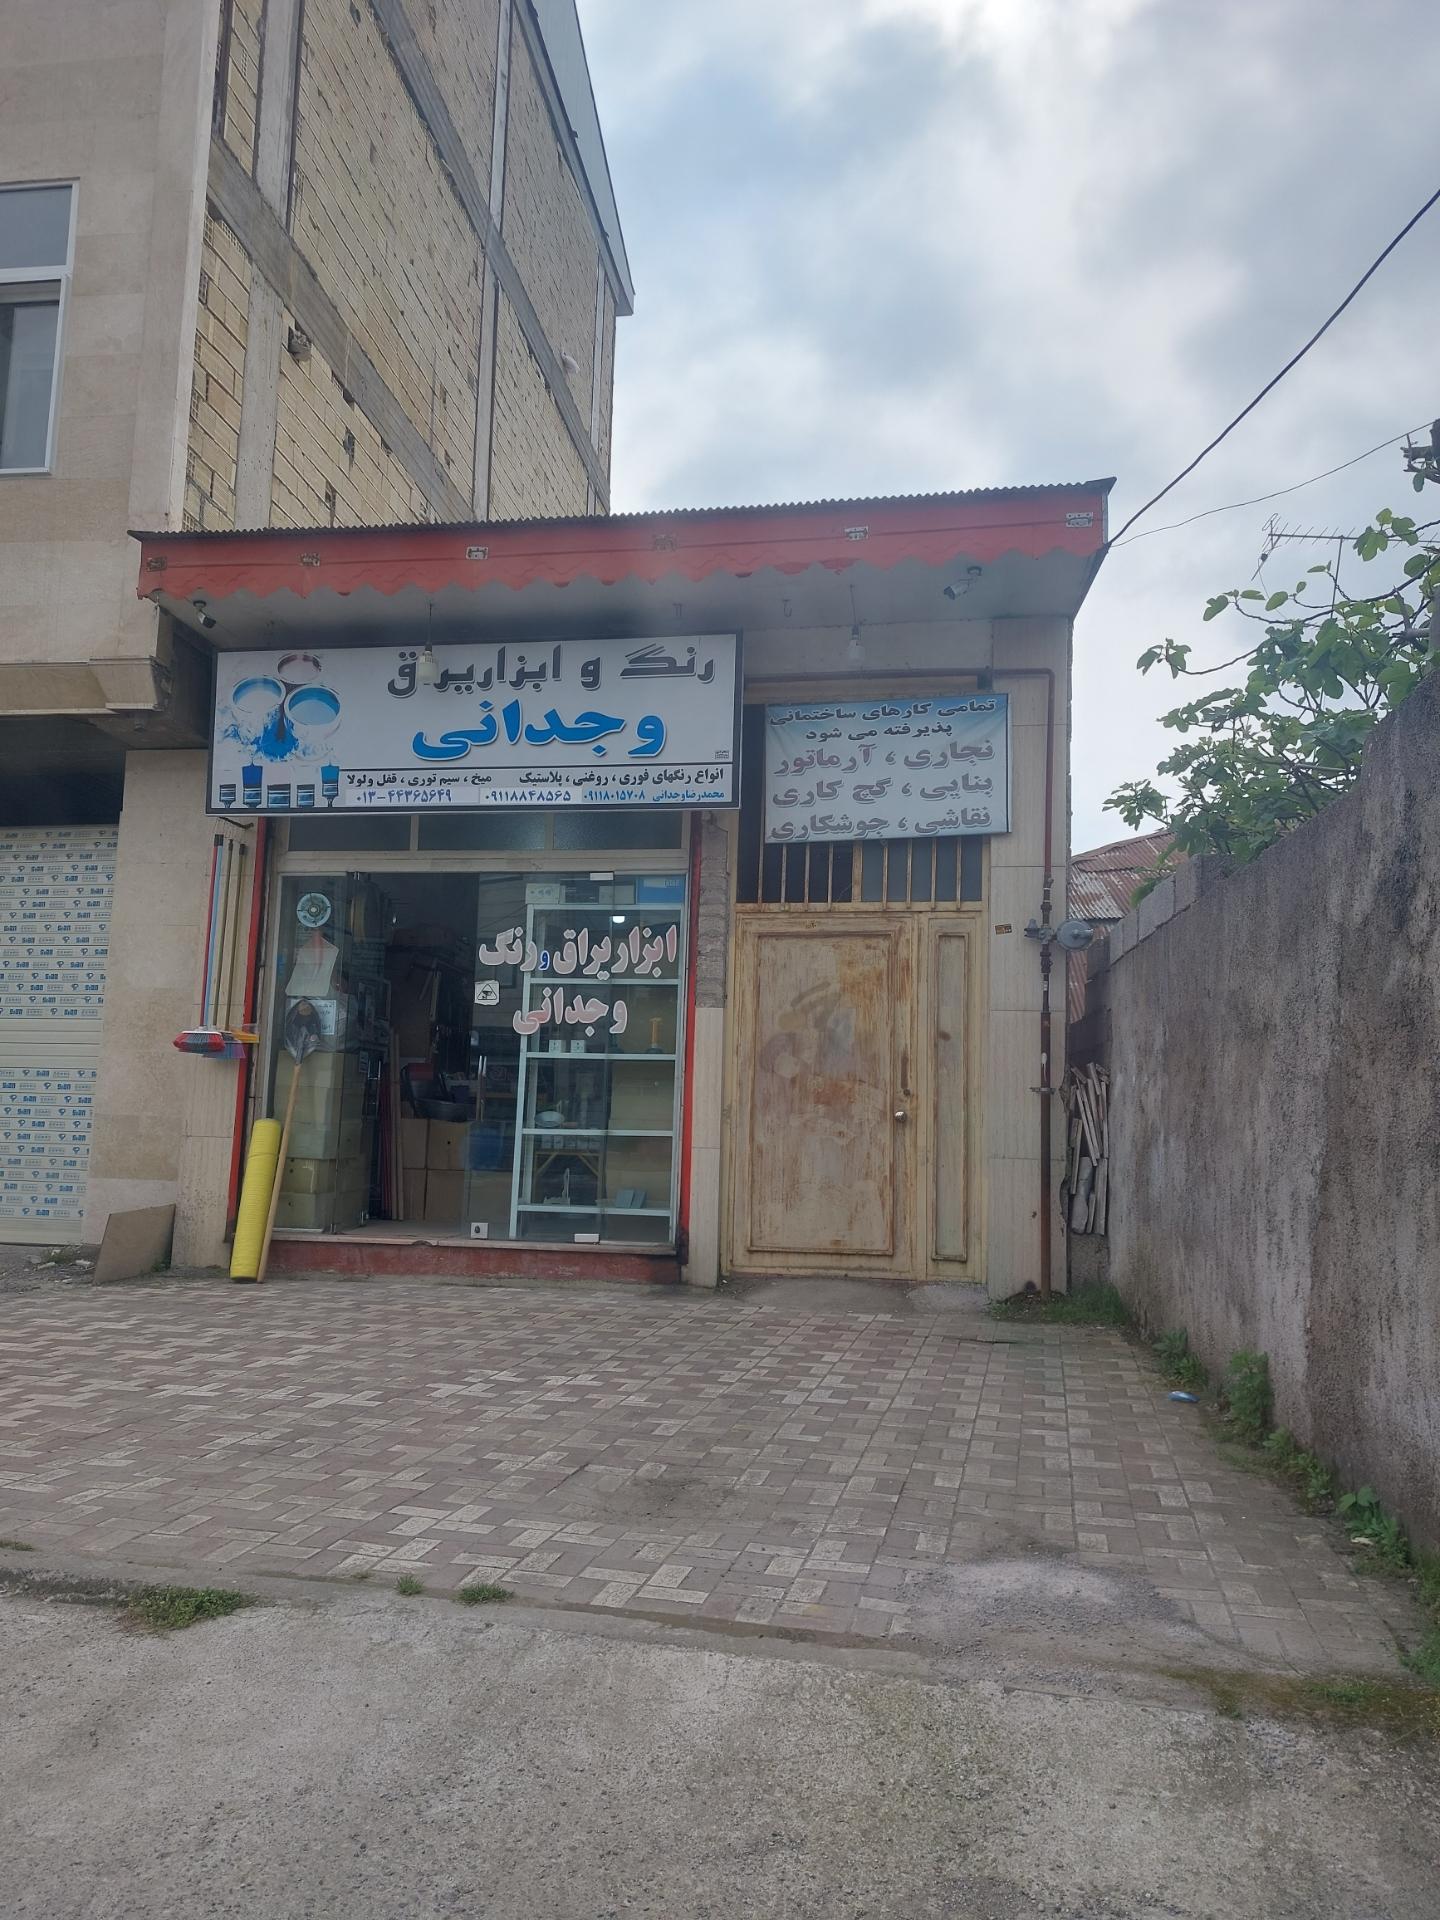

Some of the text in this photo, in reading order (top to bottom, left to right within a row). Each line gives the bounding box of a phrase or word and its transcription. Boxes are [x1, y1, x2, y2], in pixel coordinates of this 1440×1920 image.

[580, 656, 601, 691] و
[619, 643, 715, 684] رنگ
[770, 699, 996, 726] تمامی کارهای ساختمانی
[412, 698, 667, 762] وجدانی
[806, 721, 953, 743] پذیرفته می شود
[773, 743, 878, 776] آرماتور
[903, 739, 995, 769] نجاری
[376, 773, 397, 786] قفل
[408, 773, 437, 786] توری
[439, 775, 460, 786] سیم
[470, 772, 492, 785] میخ
[519, 770, 562, 787] پلاستیک
[572, 770, 609, 786] روغنی
[619, 768, 649, 786] فوری
[694, 767, 724, 784] انواع
[919, 772, 994, 801] بنایی
[772, 779, 843, 807] کاری
[851, 777, 894, 804] گچ
[770, 813, 889, 840] جوشکاری
[914, 806, 992, 836] نقاشی
[478, 926, 538, 972] رنگ
[537, 949, 550, 971] و
[512, 986, 628, 1038] وجدانی
